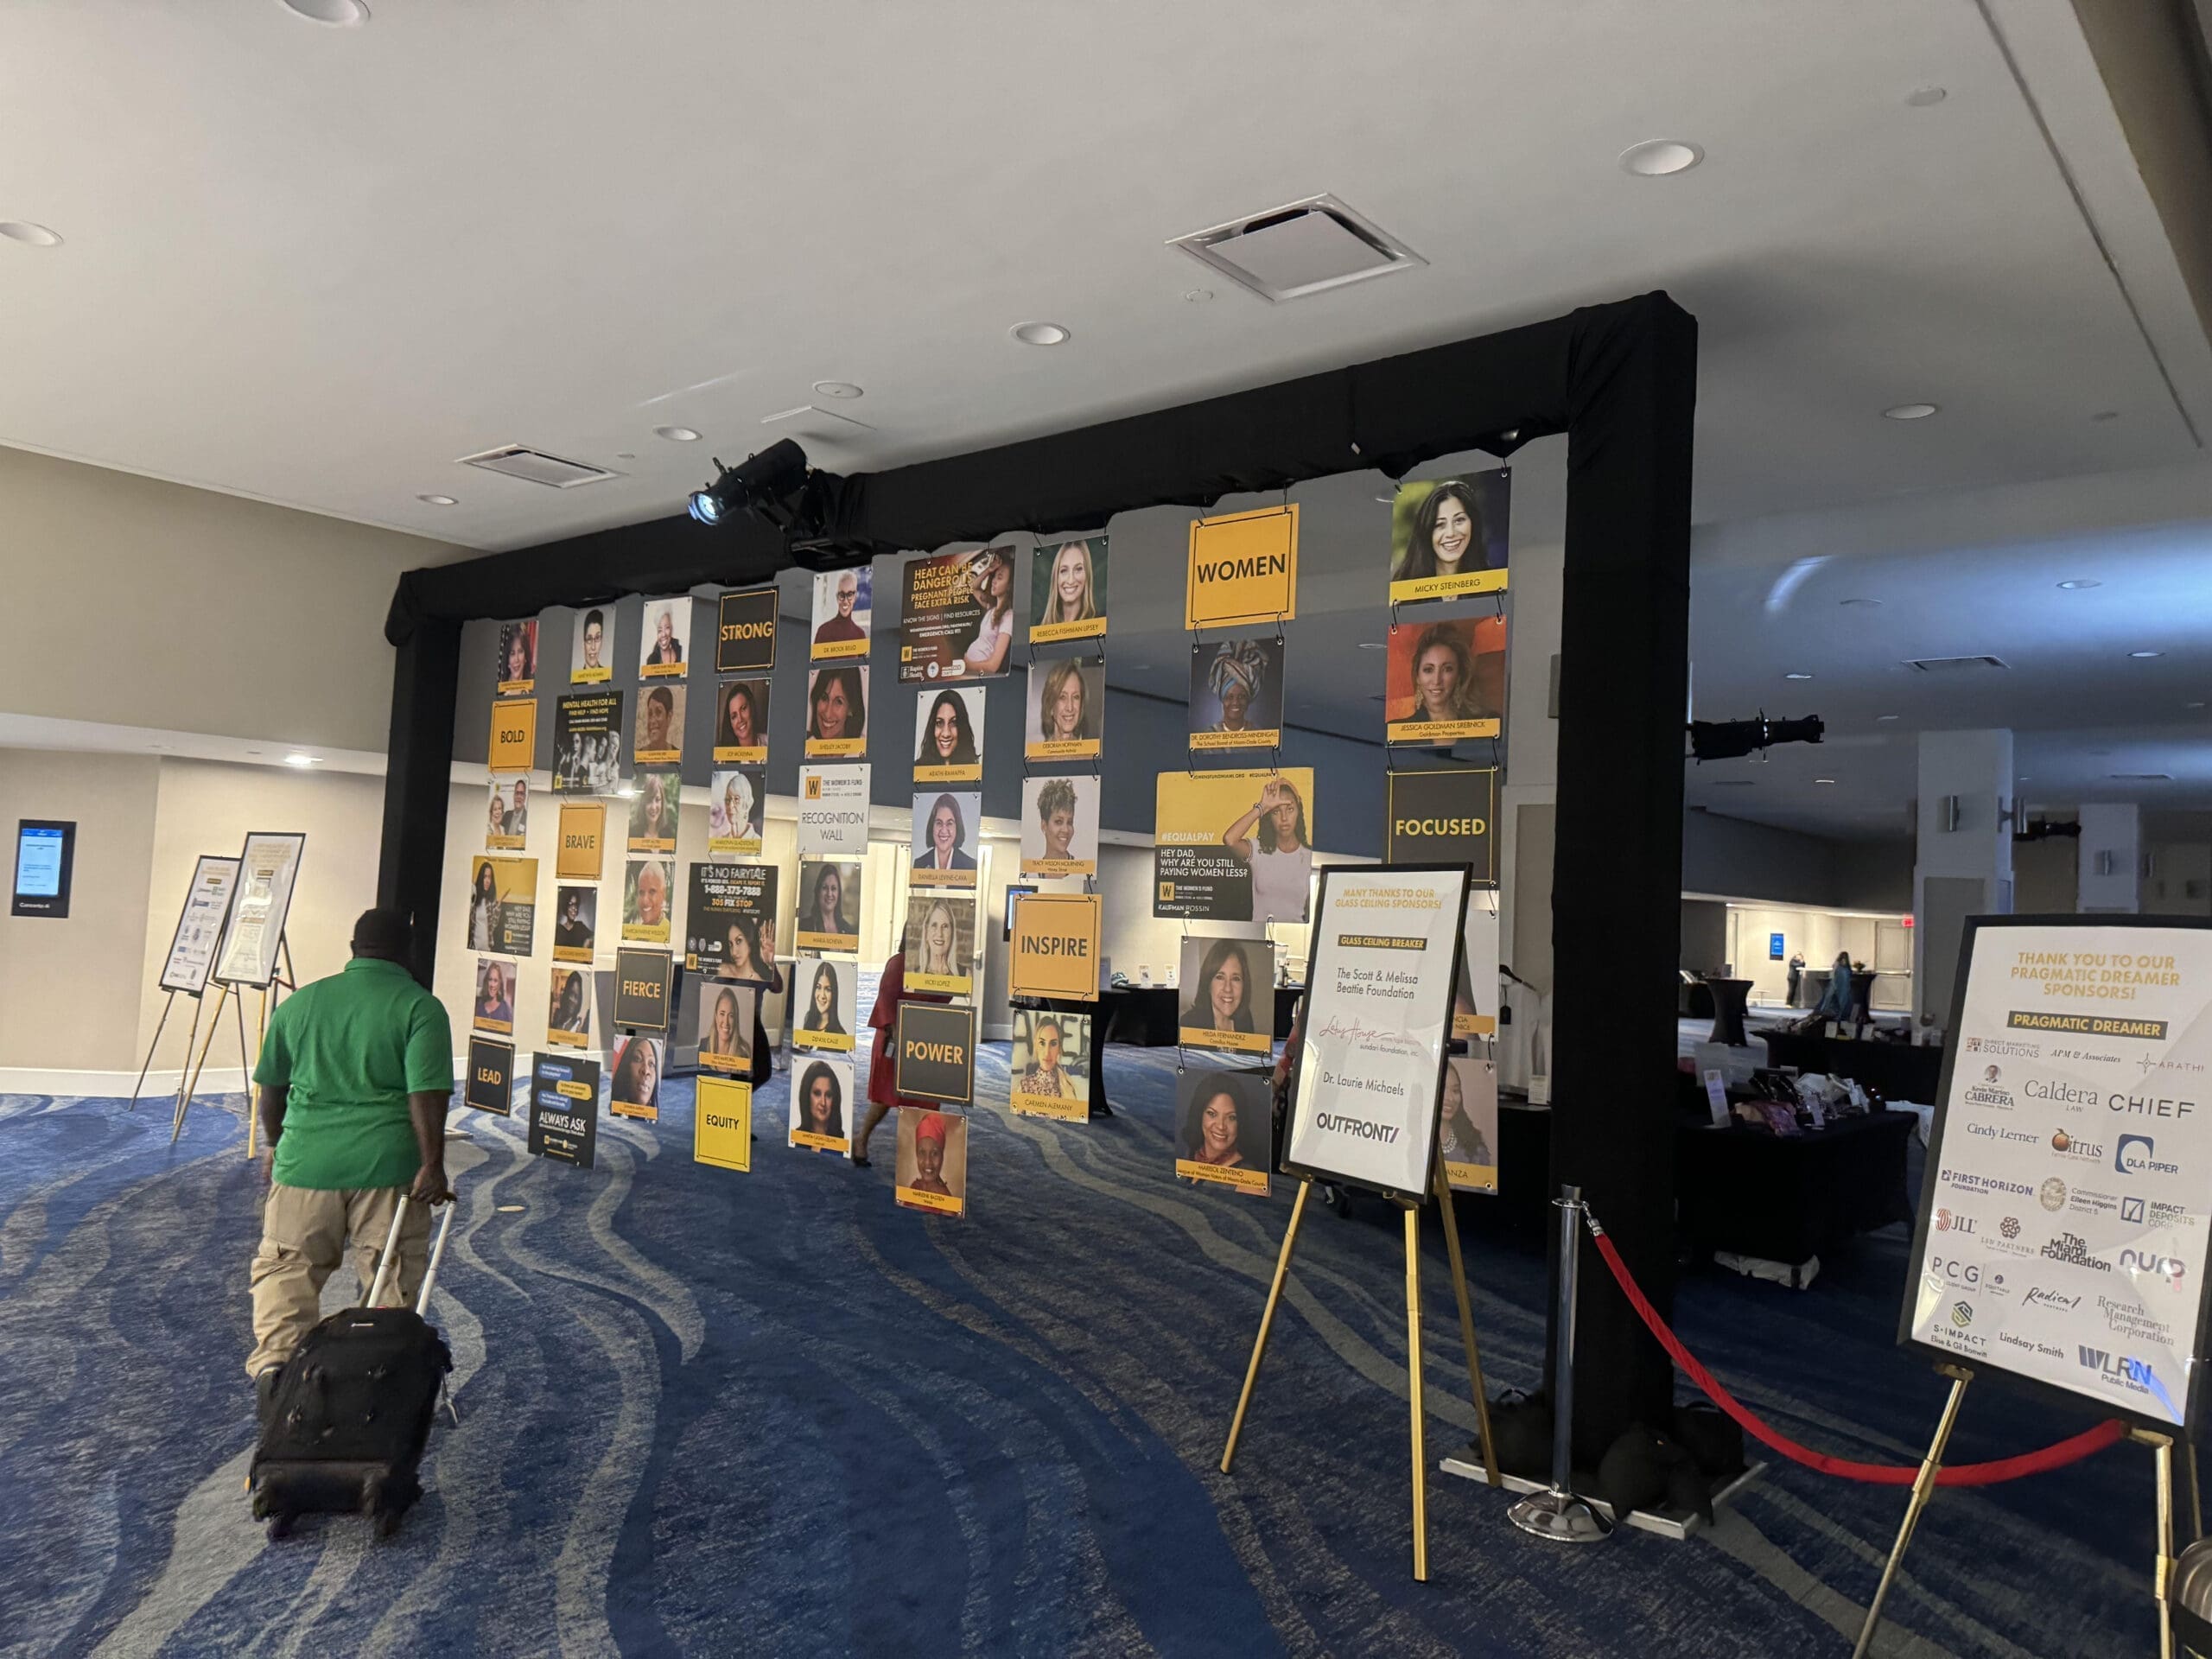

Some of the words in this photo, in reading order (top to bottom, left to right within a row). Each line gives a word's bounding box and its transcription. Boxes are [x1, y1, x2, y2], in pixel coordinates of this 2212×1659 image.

[914, 567, 938, 580] HEAT
[938, 564, 958, 576] CAN
[961, 562, 973, 572] BE
[1197, 554, 1286, 584] WOMEN
[913, 573, 972, 591] DANGEROUS
[1414, 582, 1438, 594] MICKY
[1440, 578, 1481, 591] STEINBERG
[911, 590, 948, 601] PREGNANT
[949, 587, 974, 598] PEOPLE
[914, 601, 930, 609] FACE
[931, 597, 952, 607] EXTRA
[953, 594, 969, 604] RISK
[955, 609, 981, 618] RESOURCES
[721, 621, 773, 642] STRONG
[1037, 629, 1058, 638] REBECCA
[1059, 626, 1082, 635] FISHMAN
[1083, 624, 1099, 632] LIPSEY
[563, 701, 580, 709] MENTAL
[581, 699, 597, 709] HEALTH
[608, 697, 617, 706] ALL
[1401, 723, 1421, 732] JESSICA
[1422, 722, 1452, 731] GOLDMAN
[1441, 729, 1465, 738] Properties
[500, 731, 524, 743] BOLD
[809, 780, 818, 796] W
[801, 812, 864, 824] RECOGNITION
[820, 829, 843, 842] WALL
[1395, 819, 1486, 837] FOCUSED
[565, 835, 594, 849] BRAVE
[1161, 832, 1215, 842] #EQUALPAY
[1177, 849, 1196, 858] DAD,
[1216, 859, 1235, 868] STILL
[715, 868, 729, 879] NO
[730, 868, 766, 880] FAIRYTALE
[1191, 868, 1224, 877] WOMEN
[1225, 868, 1248, 877] LESS?
[704, 885, 761, 896] 1-888-373-7888
[1162, 886, 1172, 897] W
[1343, 888, 1365, 898] MANY
[1366, 888, 1399, 899] THANKS
[1400, 889, 1413, 899] TO
[1414, 889, 1434, 899] OUR
[1335, 899, 1359, 908] GLASS
[1360, 899, 1391, 909] CEILING
[1392, 899, 1442, 910] SPONSORS!
[1021, 936, 1088, 957] INSPIRE
[1341, 937, 1362, 945] GLASS
[1363, 938, 1390, 947] CEILING
[1391, 938, 1424, 949] BREAKER
[2018, 952, 2067, 966] THANK
[2074, 954, 2107, 967] YOU
[2112, 955, 2132, 969] TO
[2137, 956, 2175, 970] OUR
[1337, 968, 1354, 981] The
[1355, 969, 1373, 982] Scott
[1376, 970, 1383, 982] &
[1386, 971, 1418, 985] Melissa
[2011, 967, 2095, 983] PRAGMATIC
[2101, 970, 2181, 987] DREAMER
[623, 982, 661, 999] FIERCE
[1337, 982, 1363, 995] Beattie
[1366, 983, 1415, 1001] Foundation
[2044, 983, 2136, 1000] SPONSORS!
[2013, 1014, 2089, 1031] PRAGMATIC
[2093, 1020, 2161, 1037] DREAMER
[1217, 1032, 1246, 1040] FERNANDEZ
[906, 1041, 963, 1065] POWER
[1983, 1044, 2039, 1058] SOLUTIONS
[2050, 1048, 2071, 1058] APM
[2073, 1050, 2080, 1058] &
[2082, 1052, 2121, 1064] Associates
[2159, 1060, 2204, 1073] ARATHI
[477, 1067, 502, 1086] LEAD
[1323, 1072, 1336, 1085] Dr.
[1337, 1074, 1363, 1090] Laurie
[1365, 1078, 1404, 1096] Michaels
[1964, 1090, 2015, 1107] CABRERA
[2024, 1079, 2098, 1105] Caldera
[1025, 1099, 1047, 1109] CARMEN
[1047, 1103, 1072, 1112] ALEMANY
[2066, 1104, 2083, 1113] LAW
[2108, 1093, 2196, 1119] CHIEF
[538, 1111, 569, 1128] ALWAYS
[570, 1117, 587, 1132] ASK
[706, 1114, 740, 1131] EQUITY
[1967, 1122, 1999, 1139] Cindy
[1999, 1128, 2040, 1144] Lerner
[1219, 1167, 1244, 1177] ZENTENO
[2126, 1158, 2145, 1170] DLA
[2147, 1161, 2179, 1175] PIPER
[1951, 1182, 1989, 1196] FOUNDATION
[1952, 1172, 1981, 1186] FIRST
[1981, 1178, 2034, 1197] HORIZON
[2071, 1186, 2118, 1201] Commissioner
[2069, 1204, 2092, 1214] District
[2070, 1195, 2092, 1205] Eileen
[2092, 1198, 2118, 1211] Higgins
[2151, 1201, 2186, 1215] IMPACT
[1950, 1215, 1978, 1234] JLL
[2149, 1210, 2196, 1225] DEPOSITS
[1997, 1239, 2035, 1255] PARTNERS
[2050, 1238, 2088, 1257] Miami
[2062, 1232, 2086, 1248] The
[2041, 1245, 2112, 1273] Foundation
[2022, 1287, 2082, 1308] Radical
[2096, 1295, 2145, 1316] Research
[2103, 1307, 2171, 1333] Management
[2108, 1319, 2175, 1346] Corporation
[1999, 1332, 2036, 1351] Lindsay
[2037, 1343, 2065, 1360] Smith
[2078, 1344, 2152, 1385] WLRN
[2101, 1373, 2124, 1388] Public
[2124, 1380, 2150, 1395] Media
